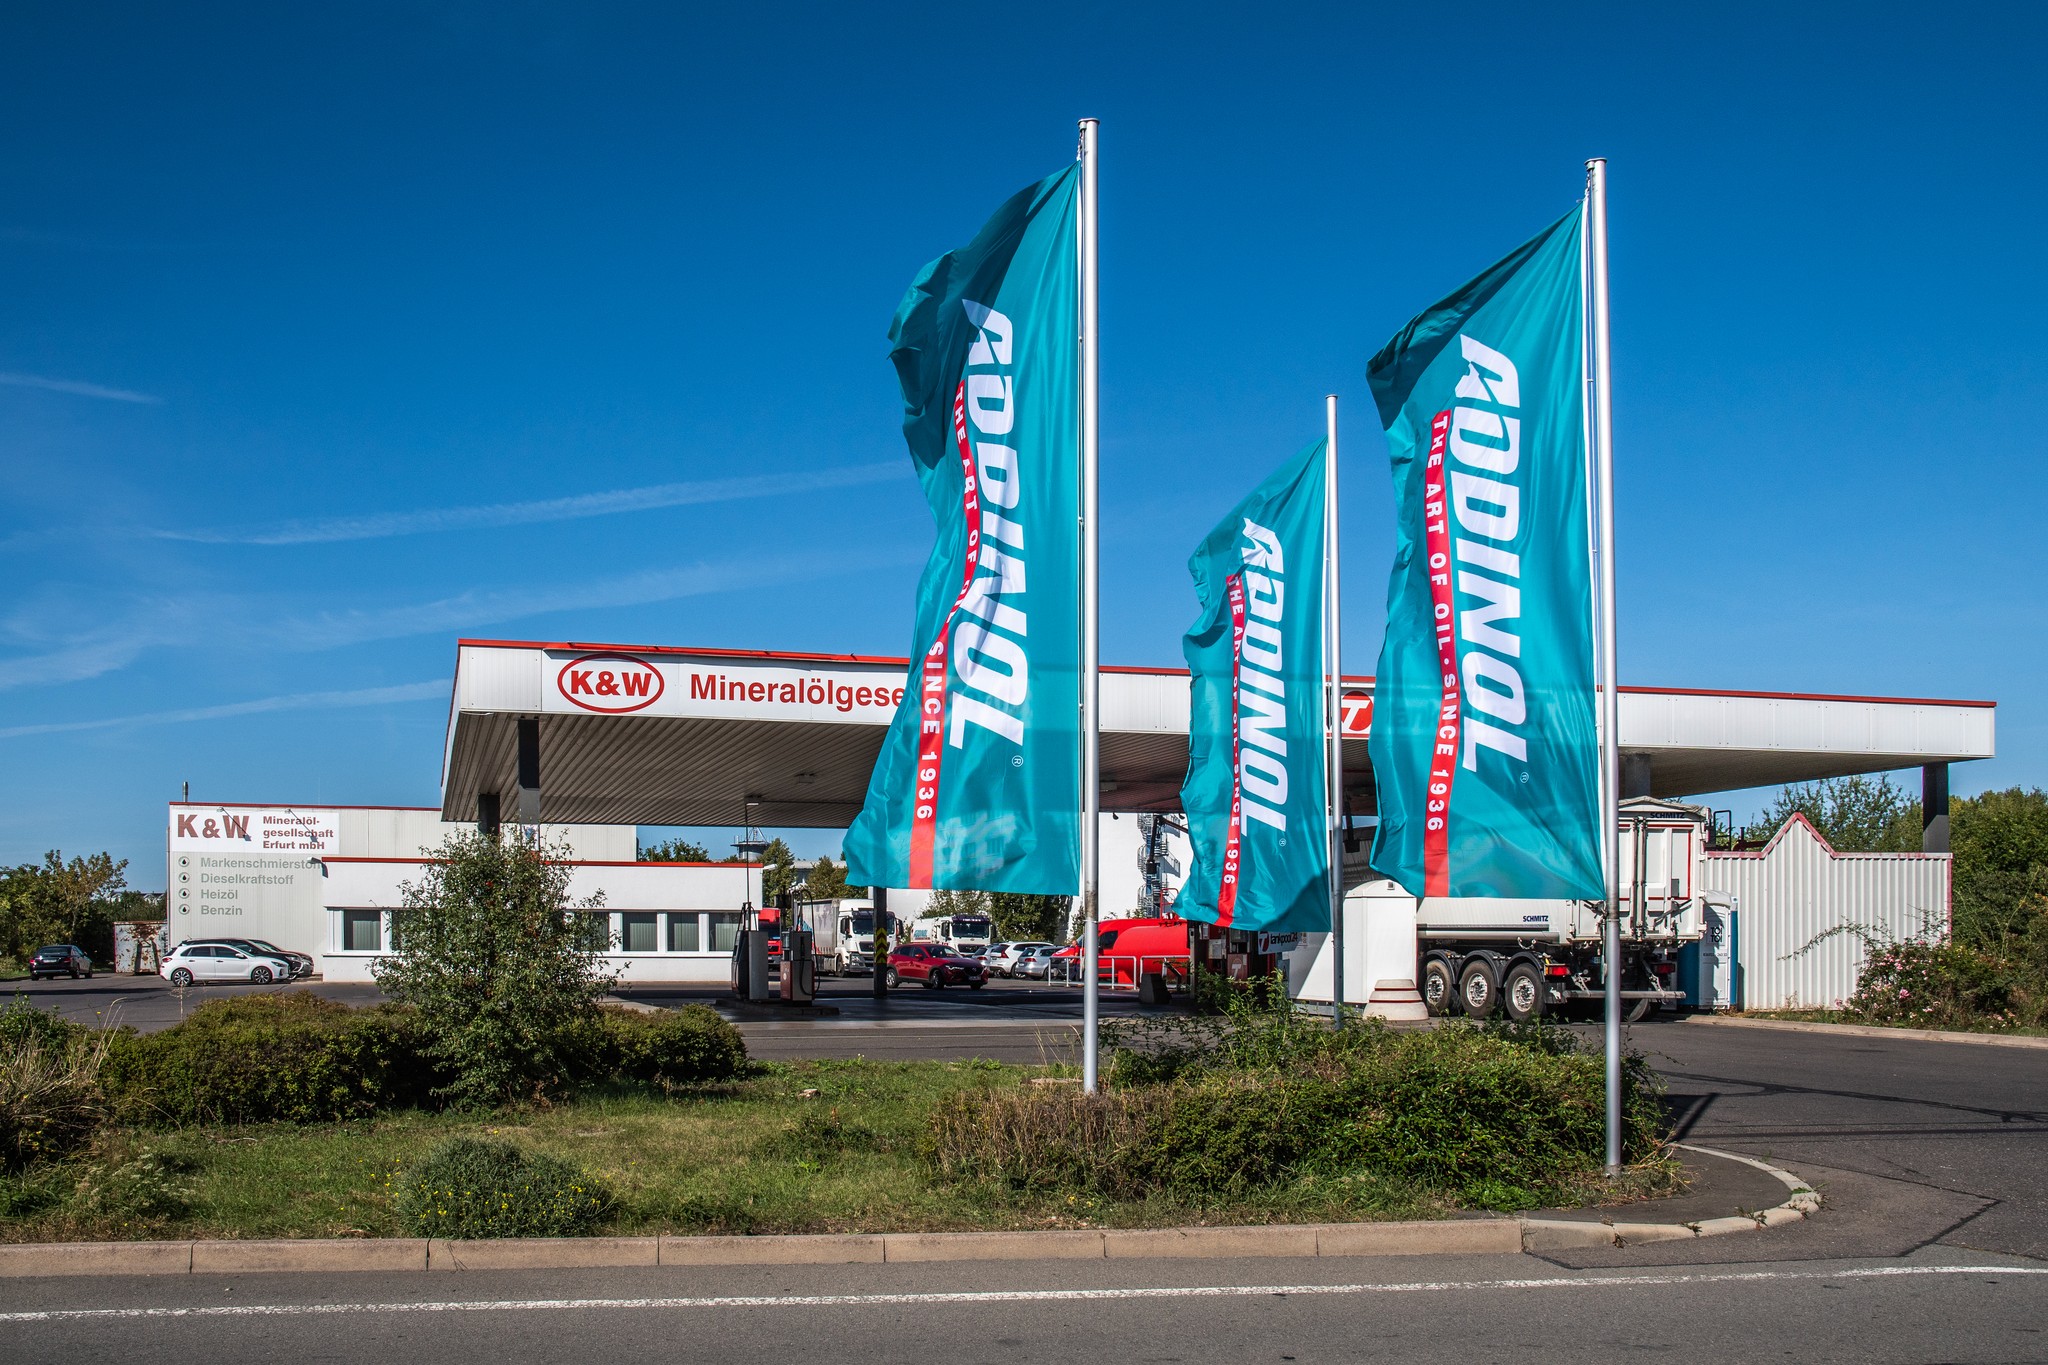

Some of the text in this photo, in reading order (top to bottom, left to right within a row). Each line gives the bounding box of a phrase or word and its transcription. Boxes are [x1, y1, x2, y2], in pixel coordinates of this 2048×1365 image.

[955, 386, 966, 444] THE
[949, 299, 1028, 749] ADDINOL
[967, 529, 978, 562] OF
[1450, 334, 1527, 772] ADDINOL
[1229, 576, 1243, 615] THE
[1426, 415, 1457, 831] THE ART OF OIL SINCE 1936
[570, 669, 652, 697] K&W
[690, 673, 905, 712] Mineralölgese
[923, 641, 944, 735] SINCE
[1239, 517, 1288, 837] ADDINOL
[916, 751, 937, 819] 1936
[1231, 764, 1239, 826] SINCE
[263, 815, 320, 826] Mineralöl-
[263, 828, 333, 838] gesellschaft
[263, 840, 325, 849] Erfurt mbH
[1224, 838, 1239, 884] 1936
[200, 873, 294, 884] Dieselkraftstoff
[200, 889, 238, 899] Heizöl
[200, 905, 243, 915] Benzin
